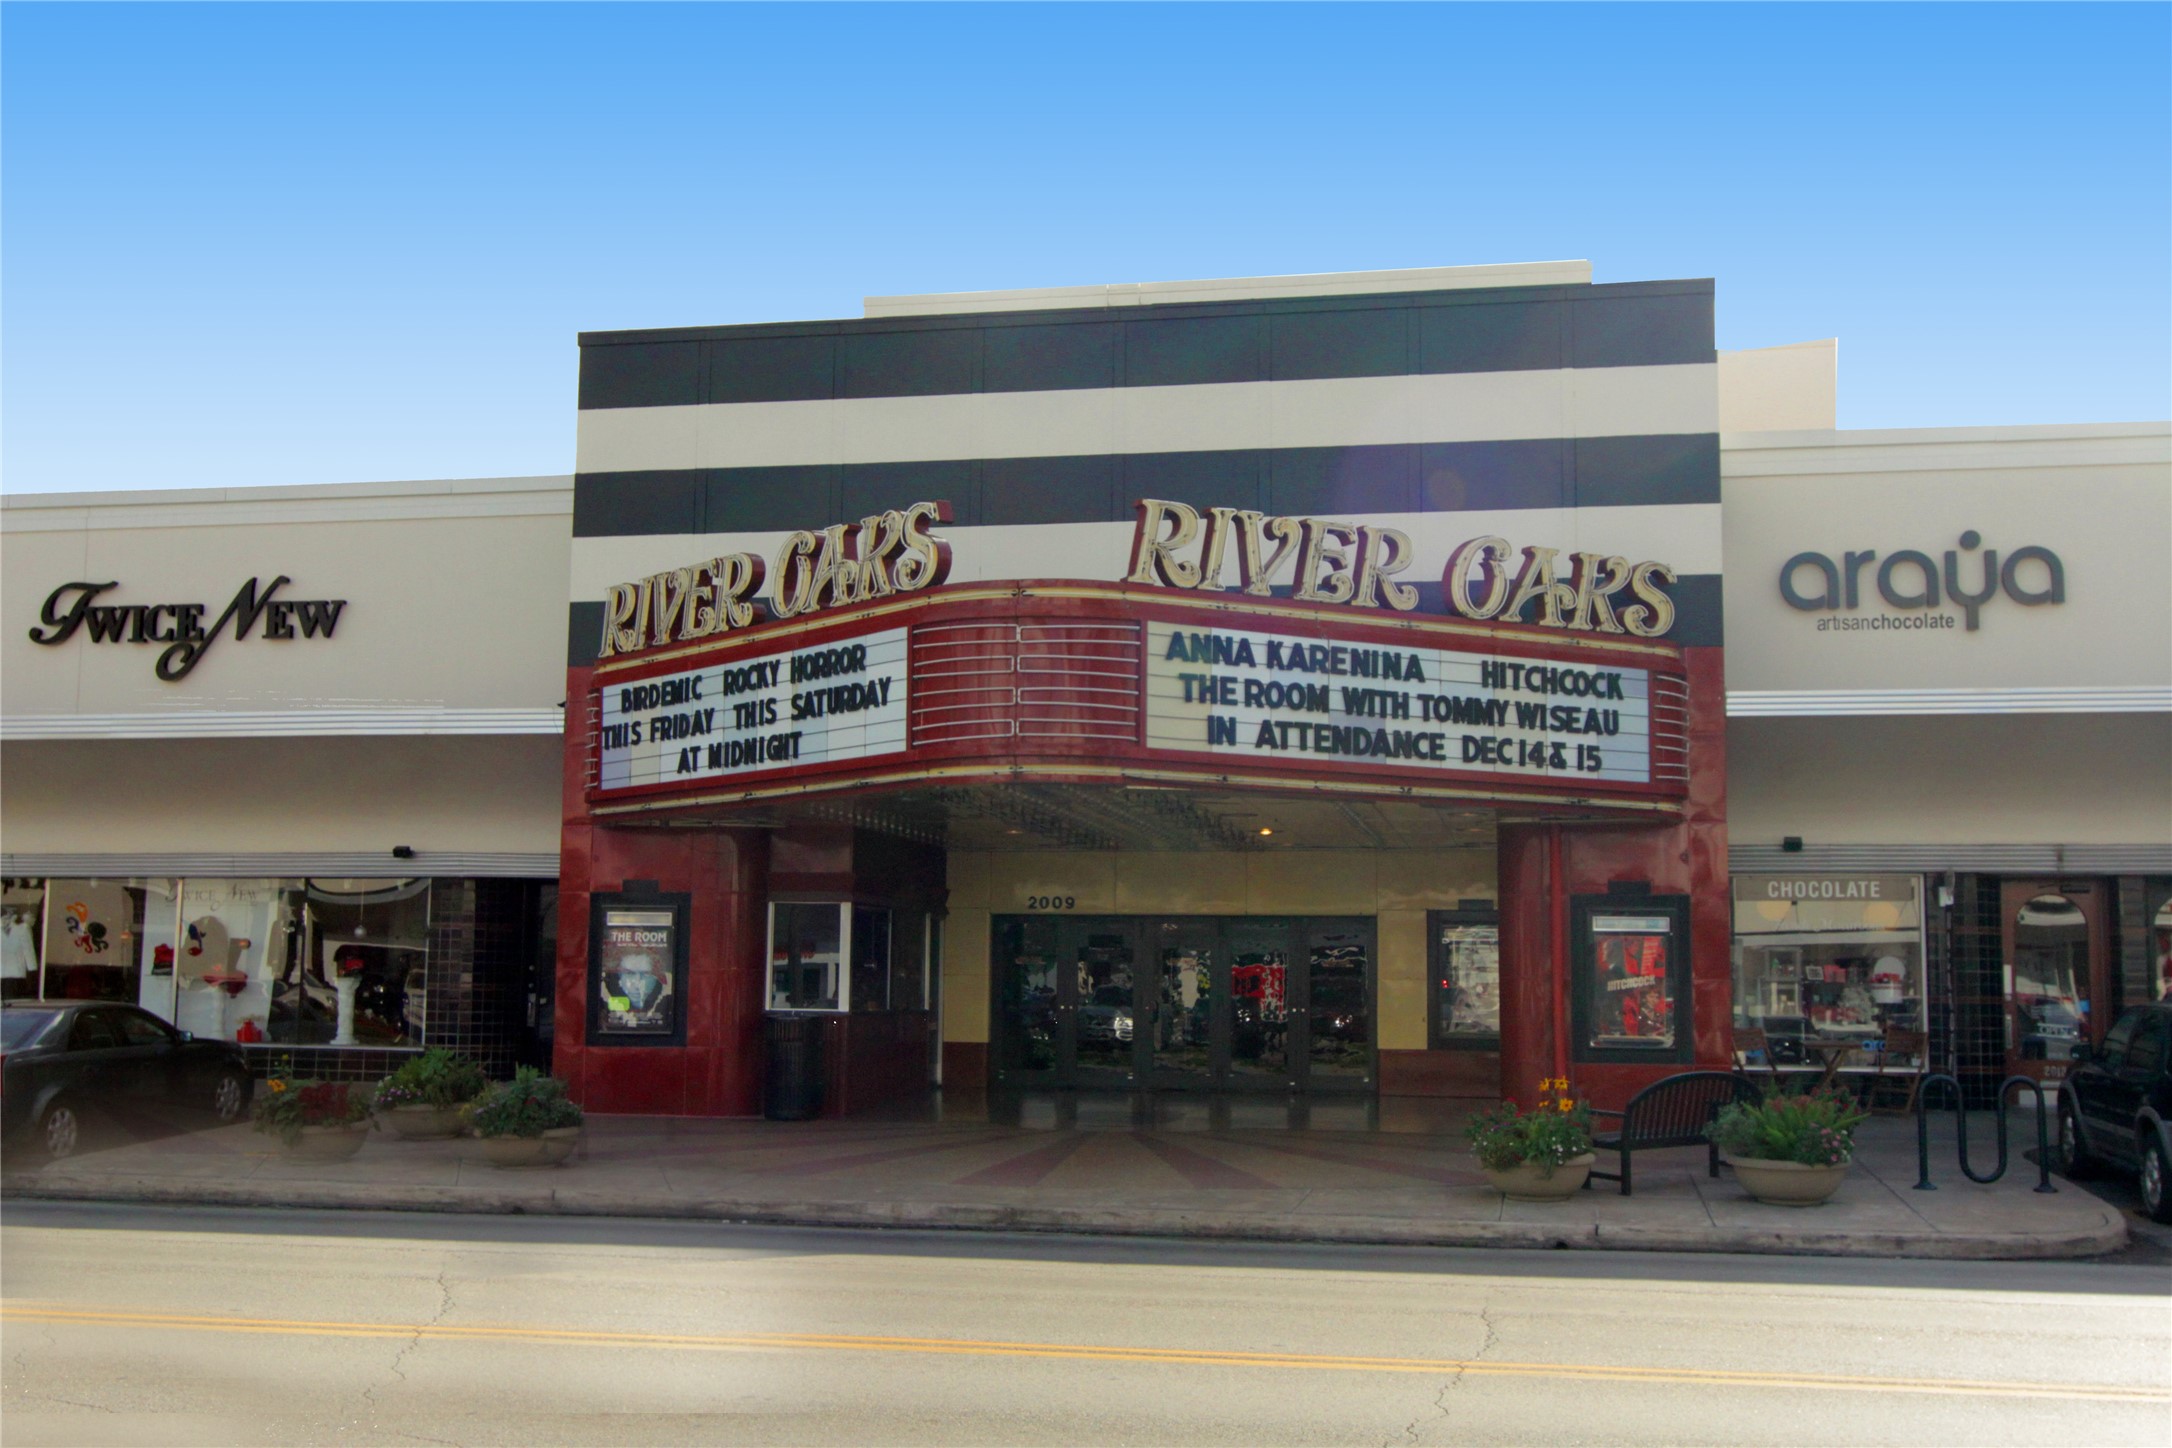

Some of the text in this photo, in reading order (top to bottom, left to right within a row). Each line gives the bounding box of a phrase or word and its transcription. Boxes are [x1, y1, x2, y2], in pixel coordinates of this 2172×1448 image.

[599, 500, 954, 657] RIVER OAKS
[1127, 498, 1678, 637] RIVER OAKS
[621, 644, 866, 714] BIRDEMIC ROCKY HORROR
[1165, 631, 1625, 701] ANNA KARENINA HITCHCOCK
[602, 677, 892, 750] THIS FRIDAY THIS SATURDAY
[1178, 672, 1620, 737] THE ROOM WITH TOMMY WISEAU
[676, 731, 802, 775] AT MIDNIGHT
[1206, 715, 1237, 746] IN
[1254, 720, 1446, 763] ATTENDANCE
[1462, 735, 1513, 766] DEC
[1577, 743, 1603, 773] 15
[1027, 895, 1076, 910] 2009
[1767, 880, 1882, 899] CHOCOLATE
[612, 931, 668, 943] THE ROOM
[1607, 974, 1656, 992] HITCHCOCK
